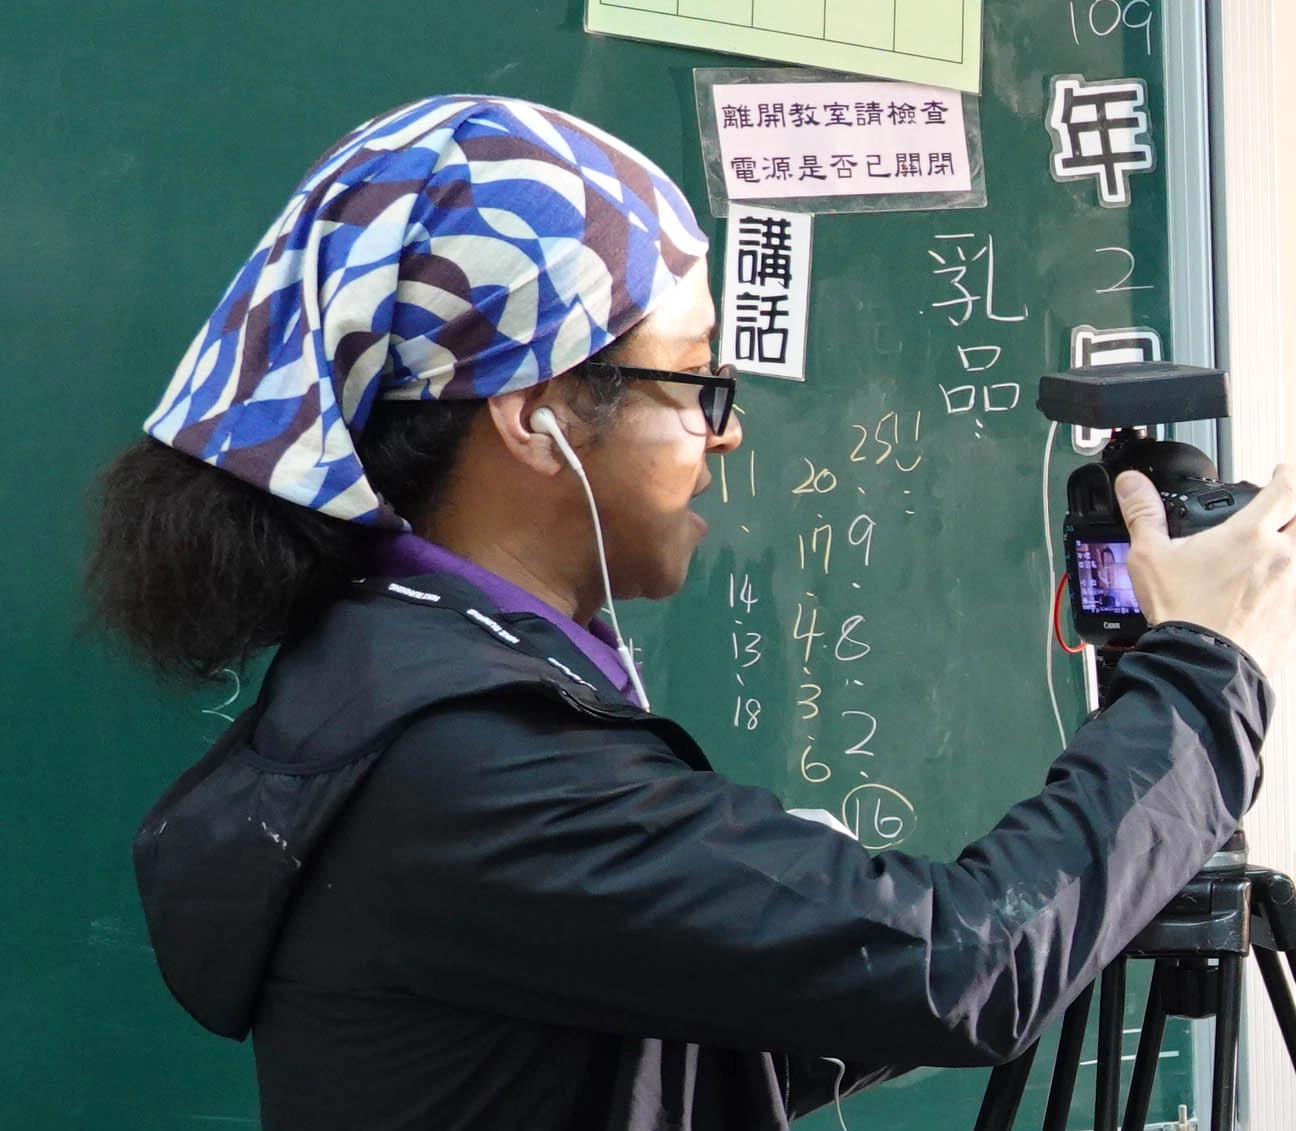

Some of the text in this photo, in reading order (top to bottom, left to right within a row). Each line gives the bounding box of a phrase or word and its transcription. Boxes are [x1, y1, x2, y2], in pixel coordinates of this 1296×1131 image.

[1069, 0, 1153, 56] 109
[722, 101, 949, 130] 離開教室請檢查
[1063, 88, 1148, 196] 年
[731, 152, 955, 184] 電源是否已關閉
[1096, 246, 1154, 293] 2
[735, 216, 792, 364] 講話
[791, 457, 837, 494] 20
[730, 573, 758, 613] 14
[732, 632, 761, 667] 13
[734, 696, 761, 729] 18
[797, 683, 822, 719] 3
[842, 711, 877, 755] 2
[801, 745, 831, 782] 6
